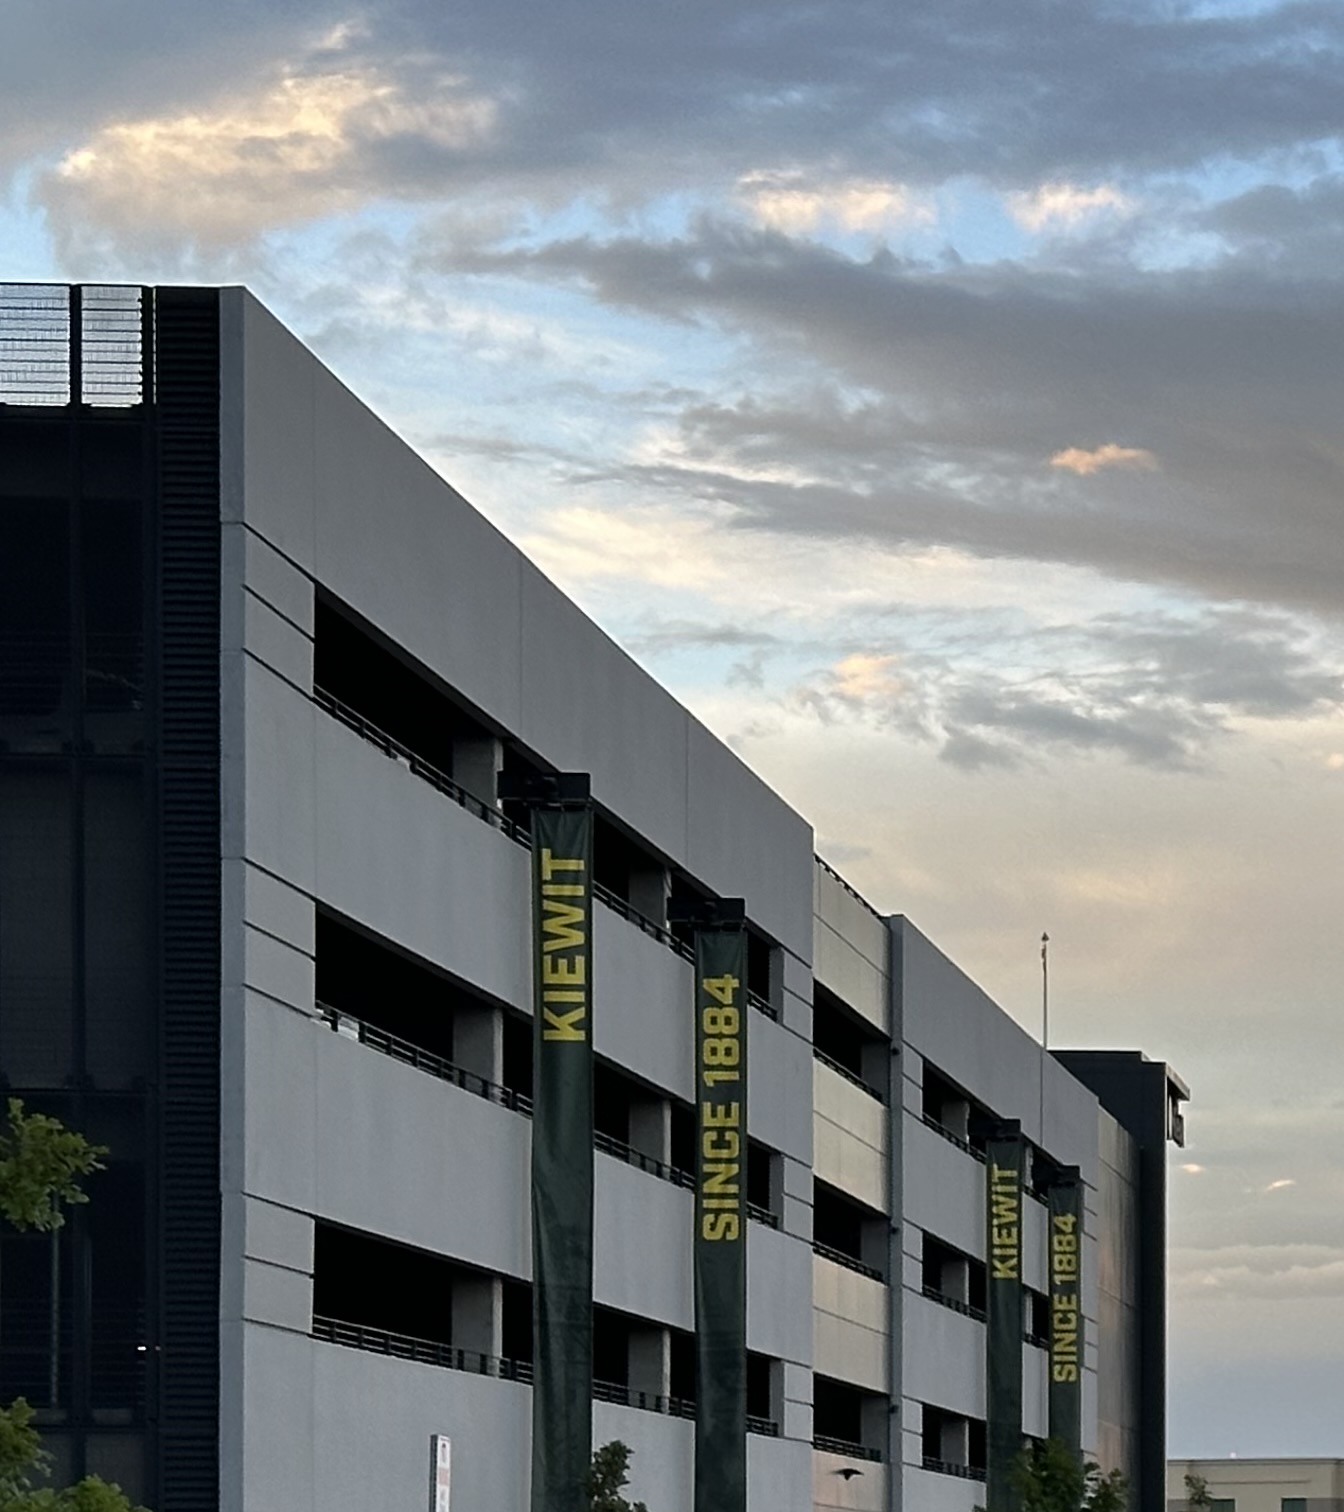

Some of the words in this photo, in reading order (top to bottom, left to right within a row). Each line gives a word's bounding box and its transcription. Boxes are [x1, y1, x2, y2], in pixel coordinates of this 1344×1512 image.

[541, 848, 586, 1042] KIEWIT
[702, 973, 740, 1087] 1884
[702, 1101, 740, 1241] SINCE
[992, 1163, 1019, 1279] KIEWIT
[1053, 1213, 1078, 1284] 1884
[1053, 1295, 1078, 1383] SINCE
